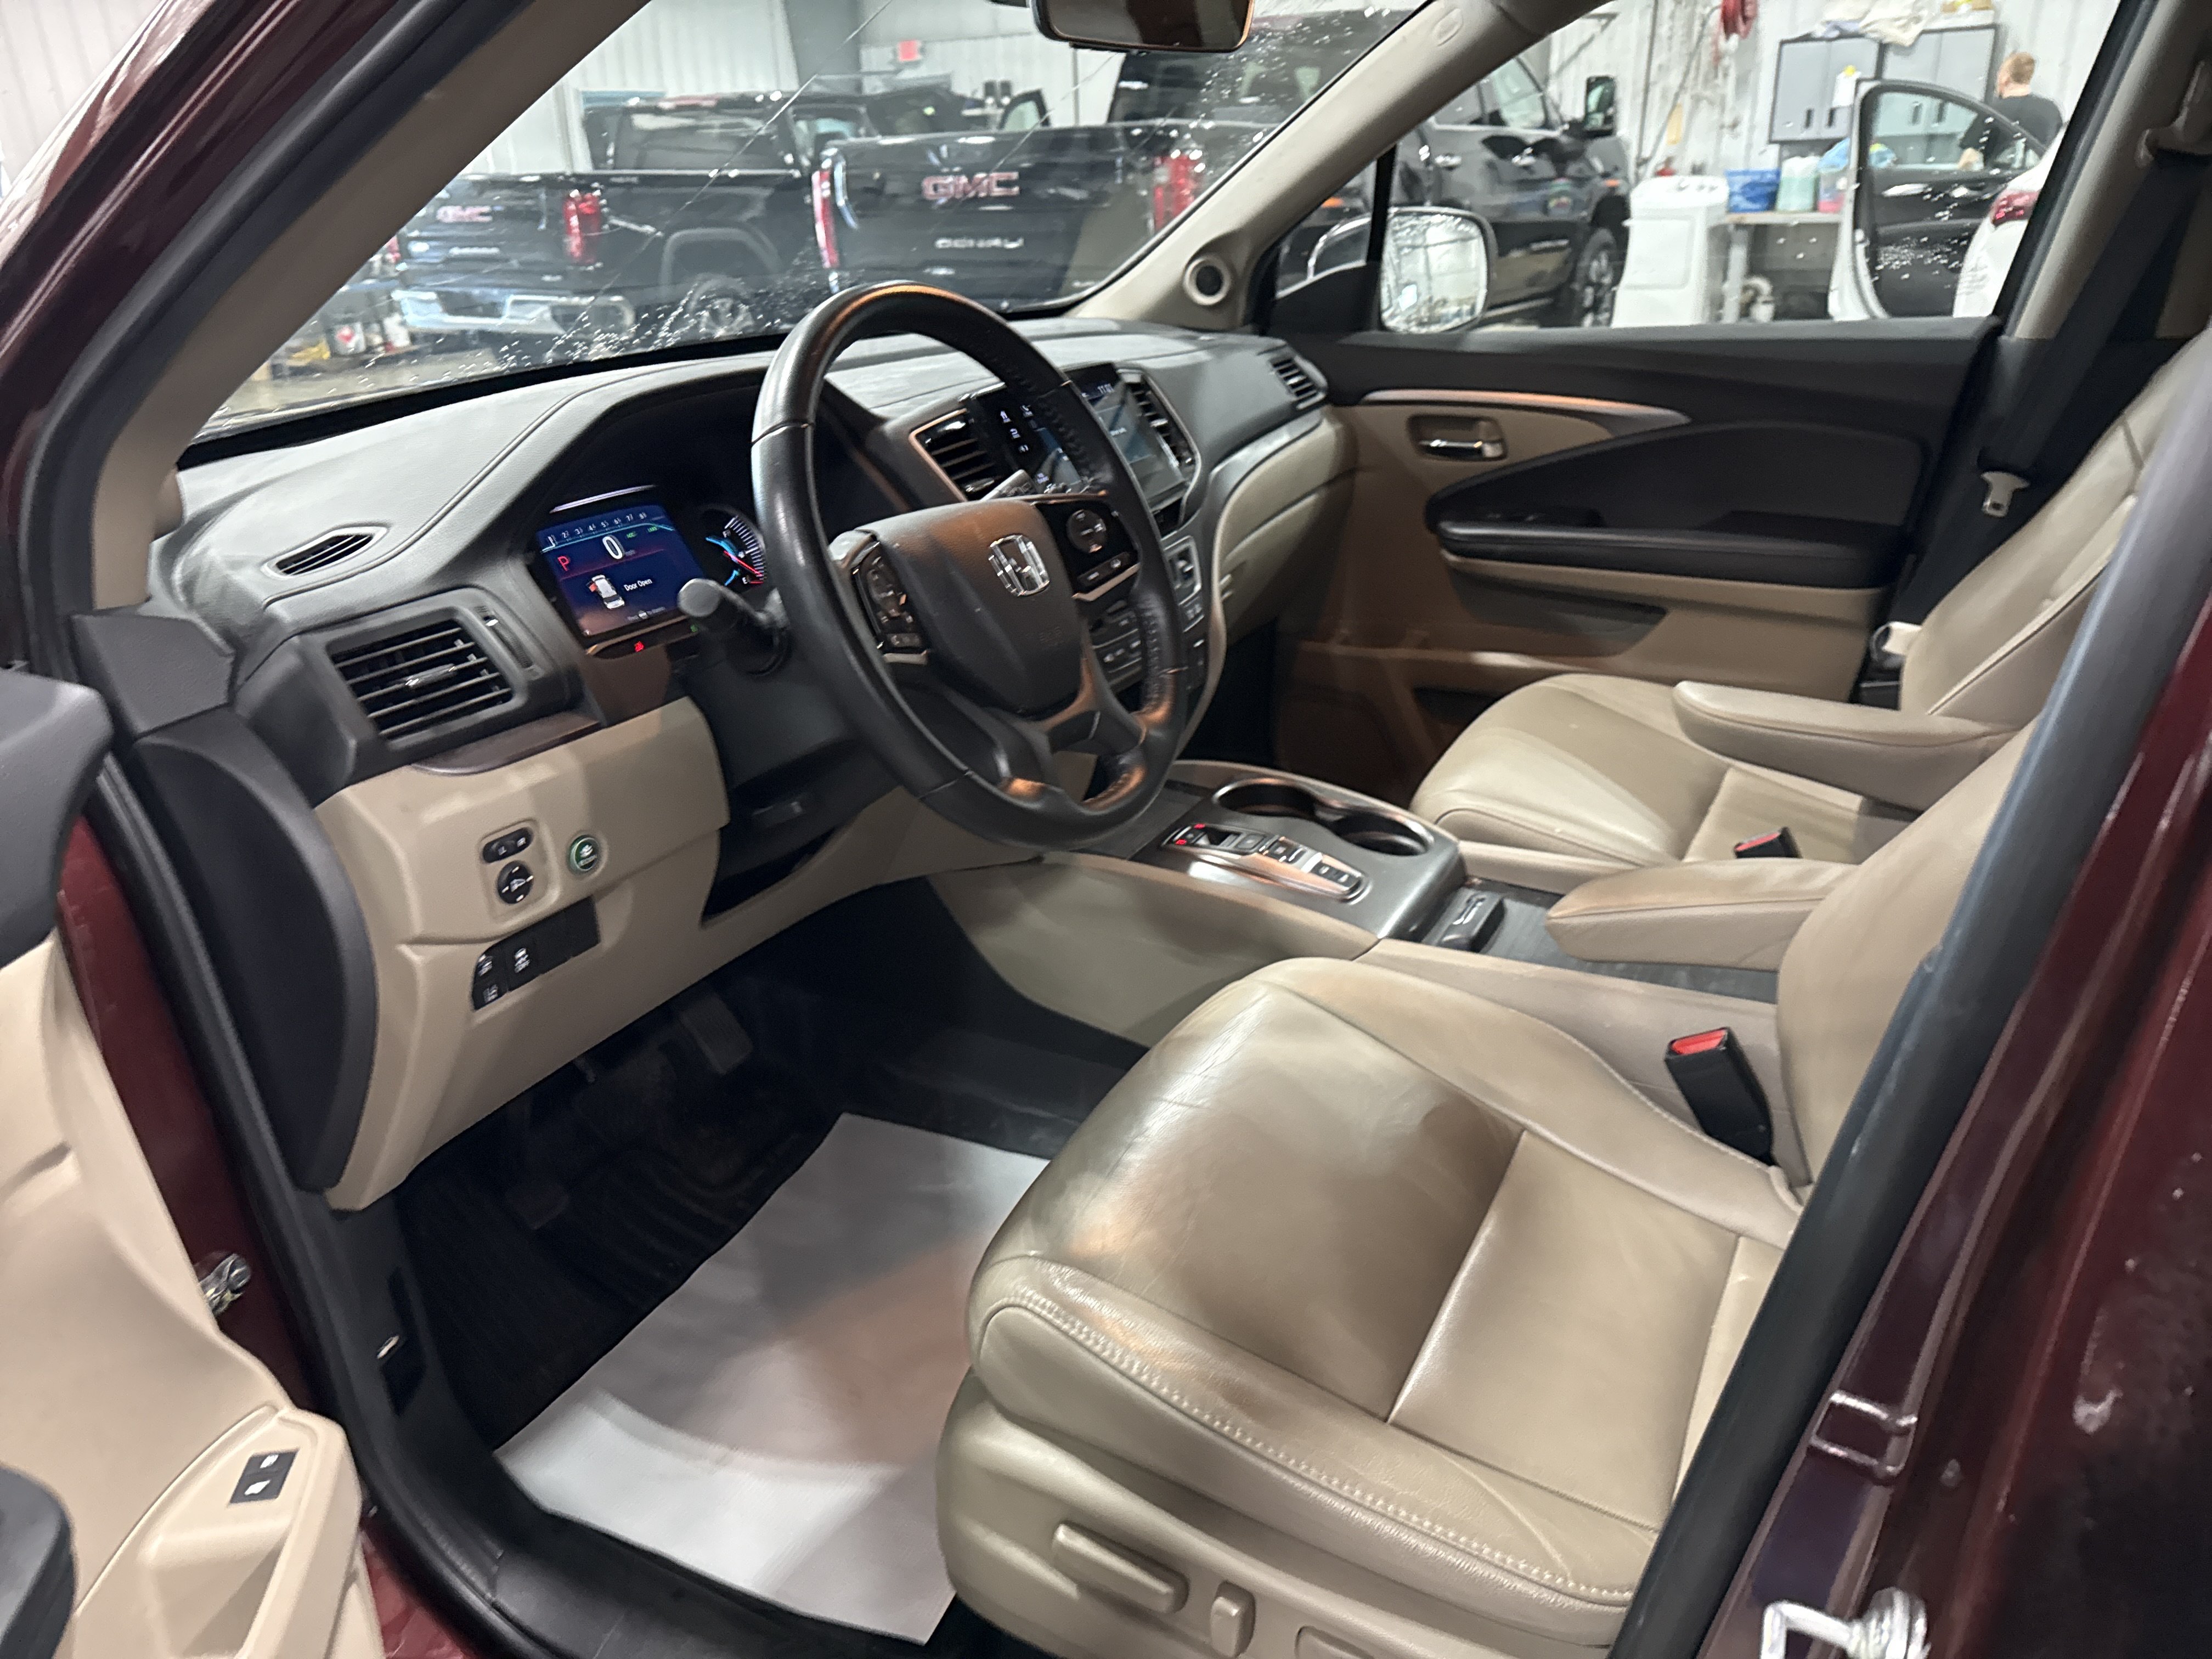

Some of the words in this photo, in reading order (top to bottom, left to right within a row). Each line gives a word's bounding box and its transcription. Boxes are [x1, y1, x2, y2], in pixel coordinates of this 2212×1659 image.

[922, 171, 1020, 200] GMC
[602, 535, 623, 560] 0
[557, 555, 571, 571] P
[637, 579, 653, 588] Open
